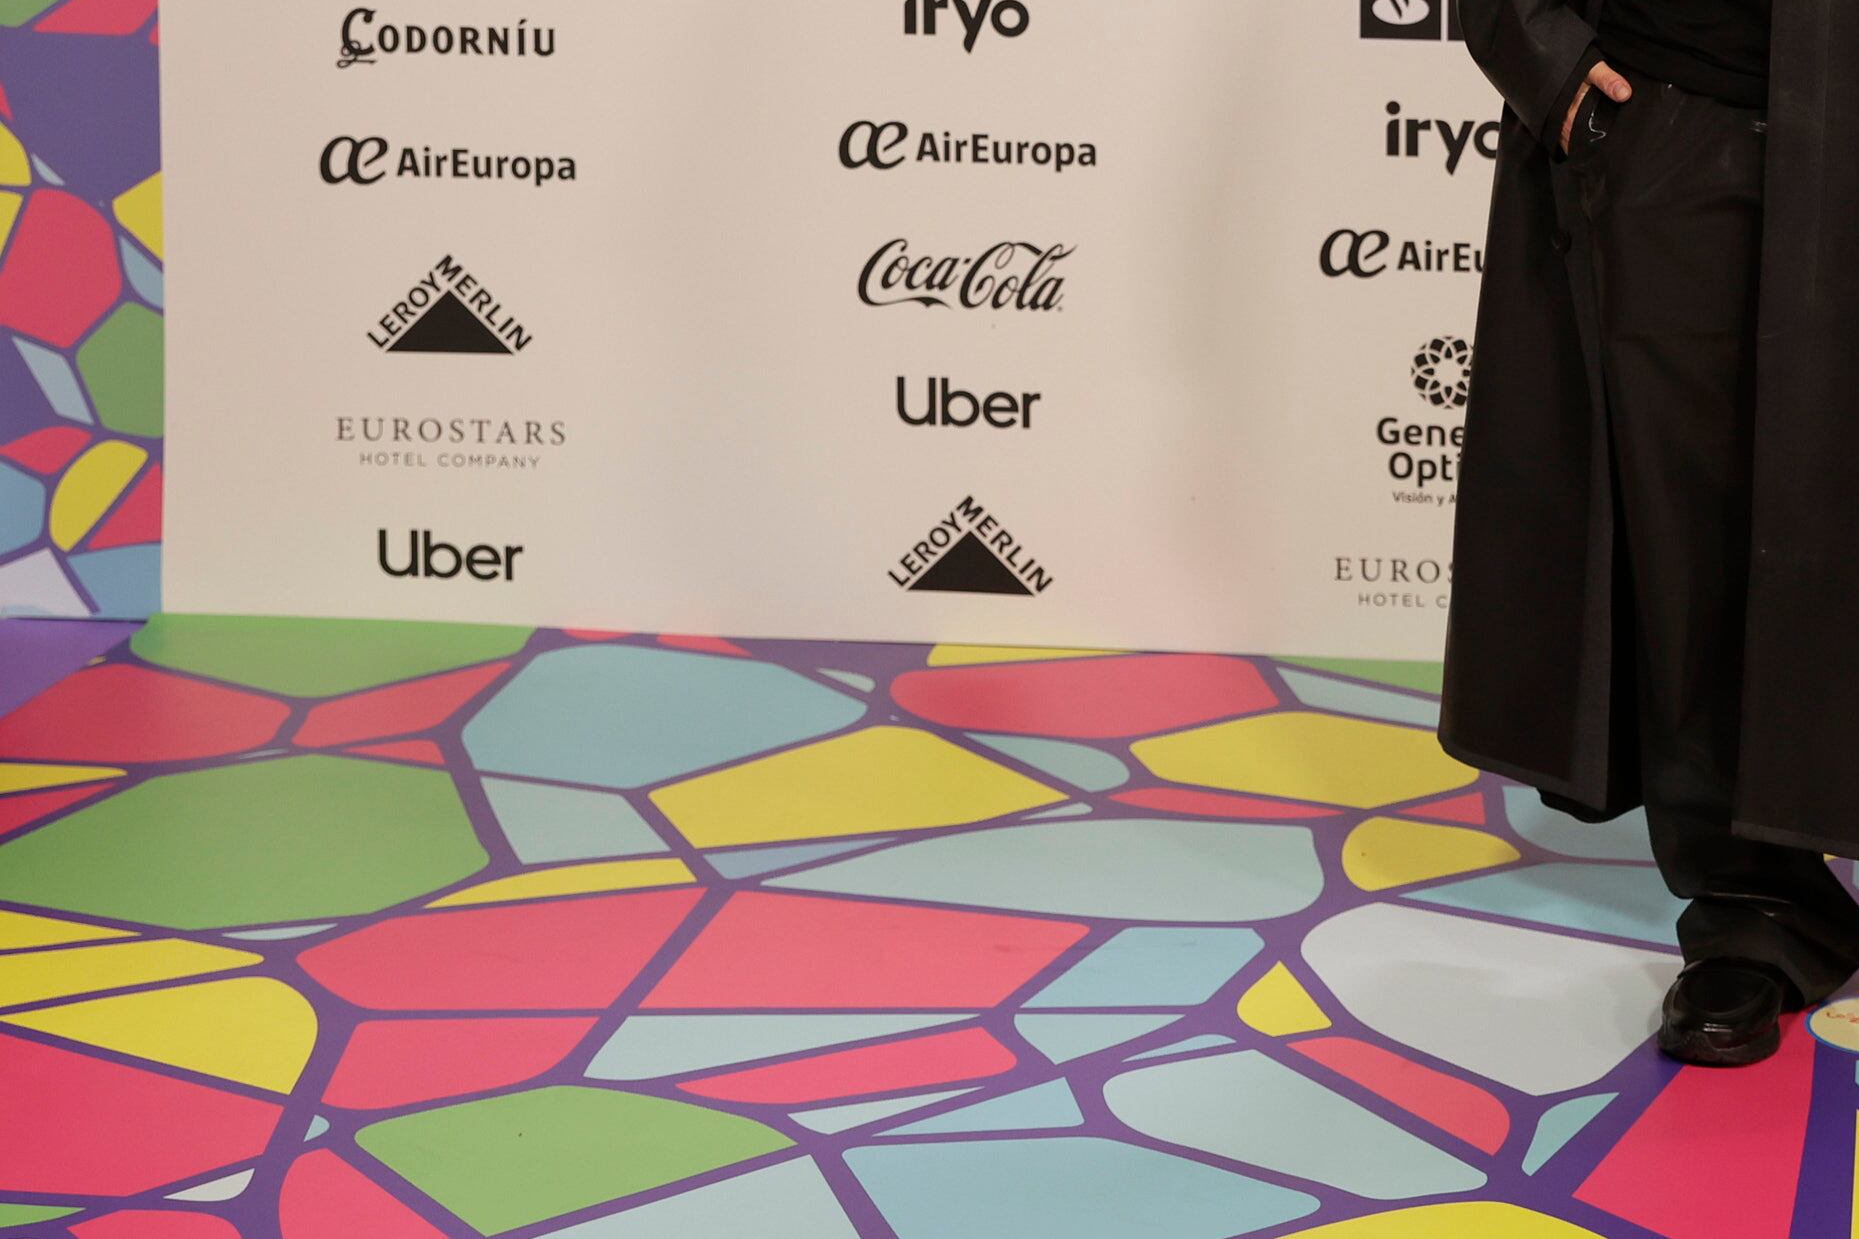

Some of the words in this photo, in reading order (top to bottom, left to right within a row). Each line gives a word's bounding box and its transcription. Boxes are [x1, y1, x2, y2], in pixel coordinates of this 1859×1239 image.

[857, 237, 1079, 312] Coca-Cola
[366, 271, 443, 349] LEROY
[435, 254, 533, 353] MERLIN
[896, 375, 1041, 429] Uber
[336, 416, 567, 447] EUROSTARS
[1376, 416, 1465, 447] Gene
[359, 452, 427, 467] HOTEL
[437, 452, 542, 471] COMPANY
[377, 528, 525, 582] Uber
[887, 511, 961, 588] LEROY
[956, 495, 1054, 594] MERLIN
[1358, 592, 1425, 608] HOTEL
